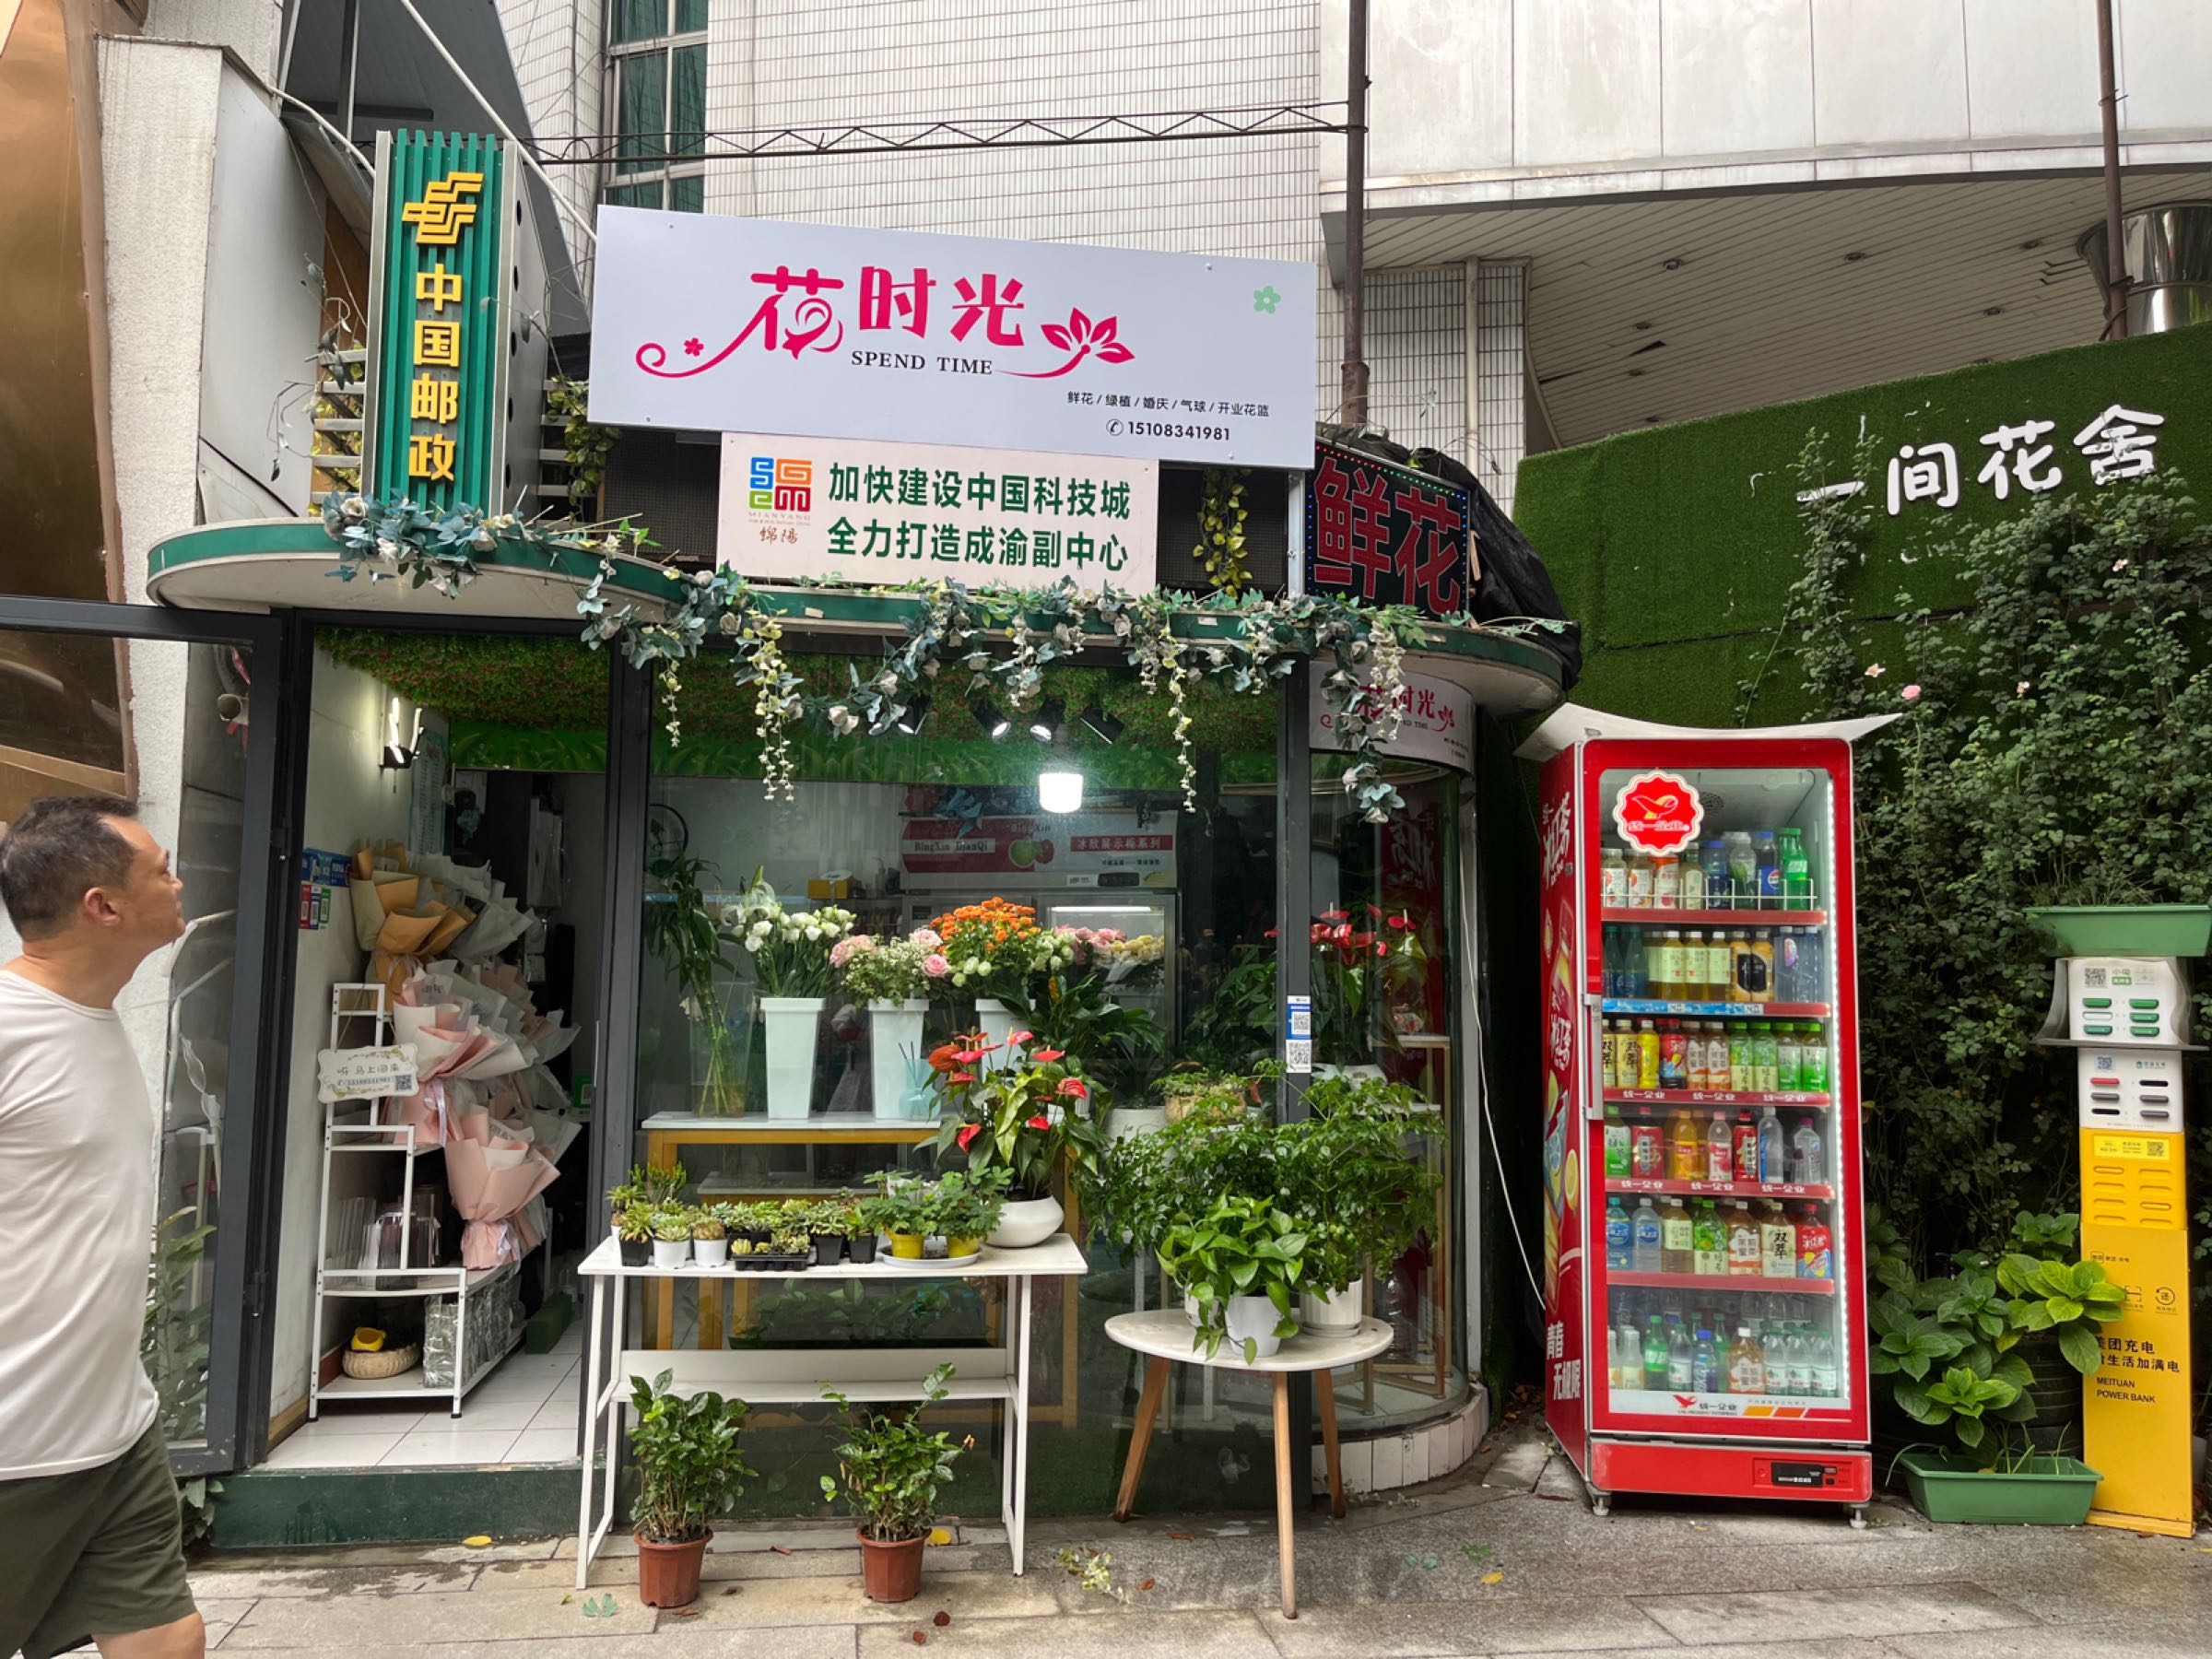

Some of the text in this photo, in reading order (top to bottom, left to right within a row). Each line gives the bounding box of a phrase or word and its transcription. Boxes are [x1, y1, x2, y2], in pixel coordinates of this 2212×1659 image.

[408, 264, 463, 482] 中国邮政
[851, 350, 994, 376] SPEND TIME
[1127, 421, 1231, 441] 15108341981
[1796, 404, 2164, 515] 一间花舍
[828, 463, 1130, 520] 加快建设中国科技城
[827, 516, 1129, 571] 全力打造成渝副中心
[1313, 456, 1462, 615] 鲜花
[2097, 1377, 2136, 1389] MEITUAN
[2097, 1389, 2156, 1404] POWER BANK
